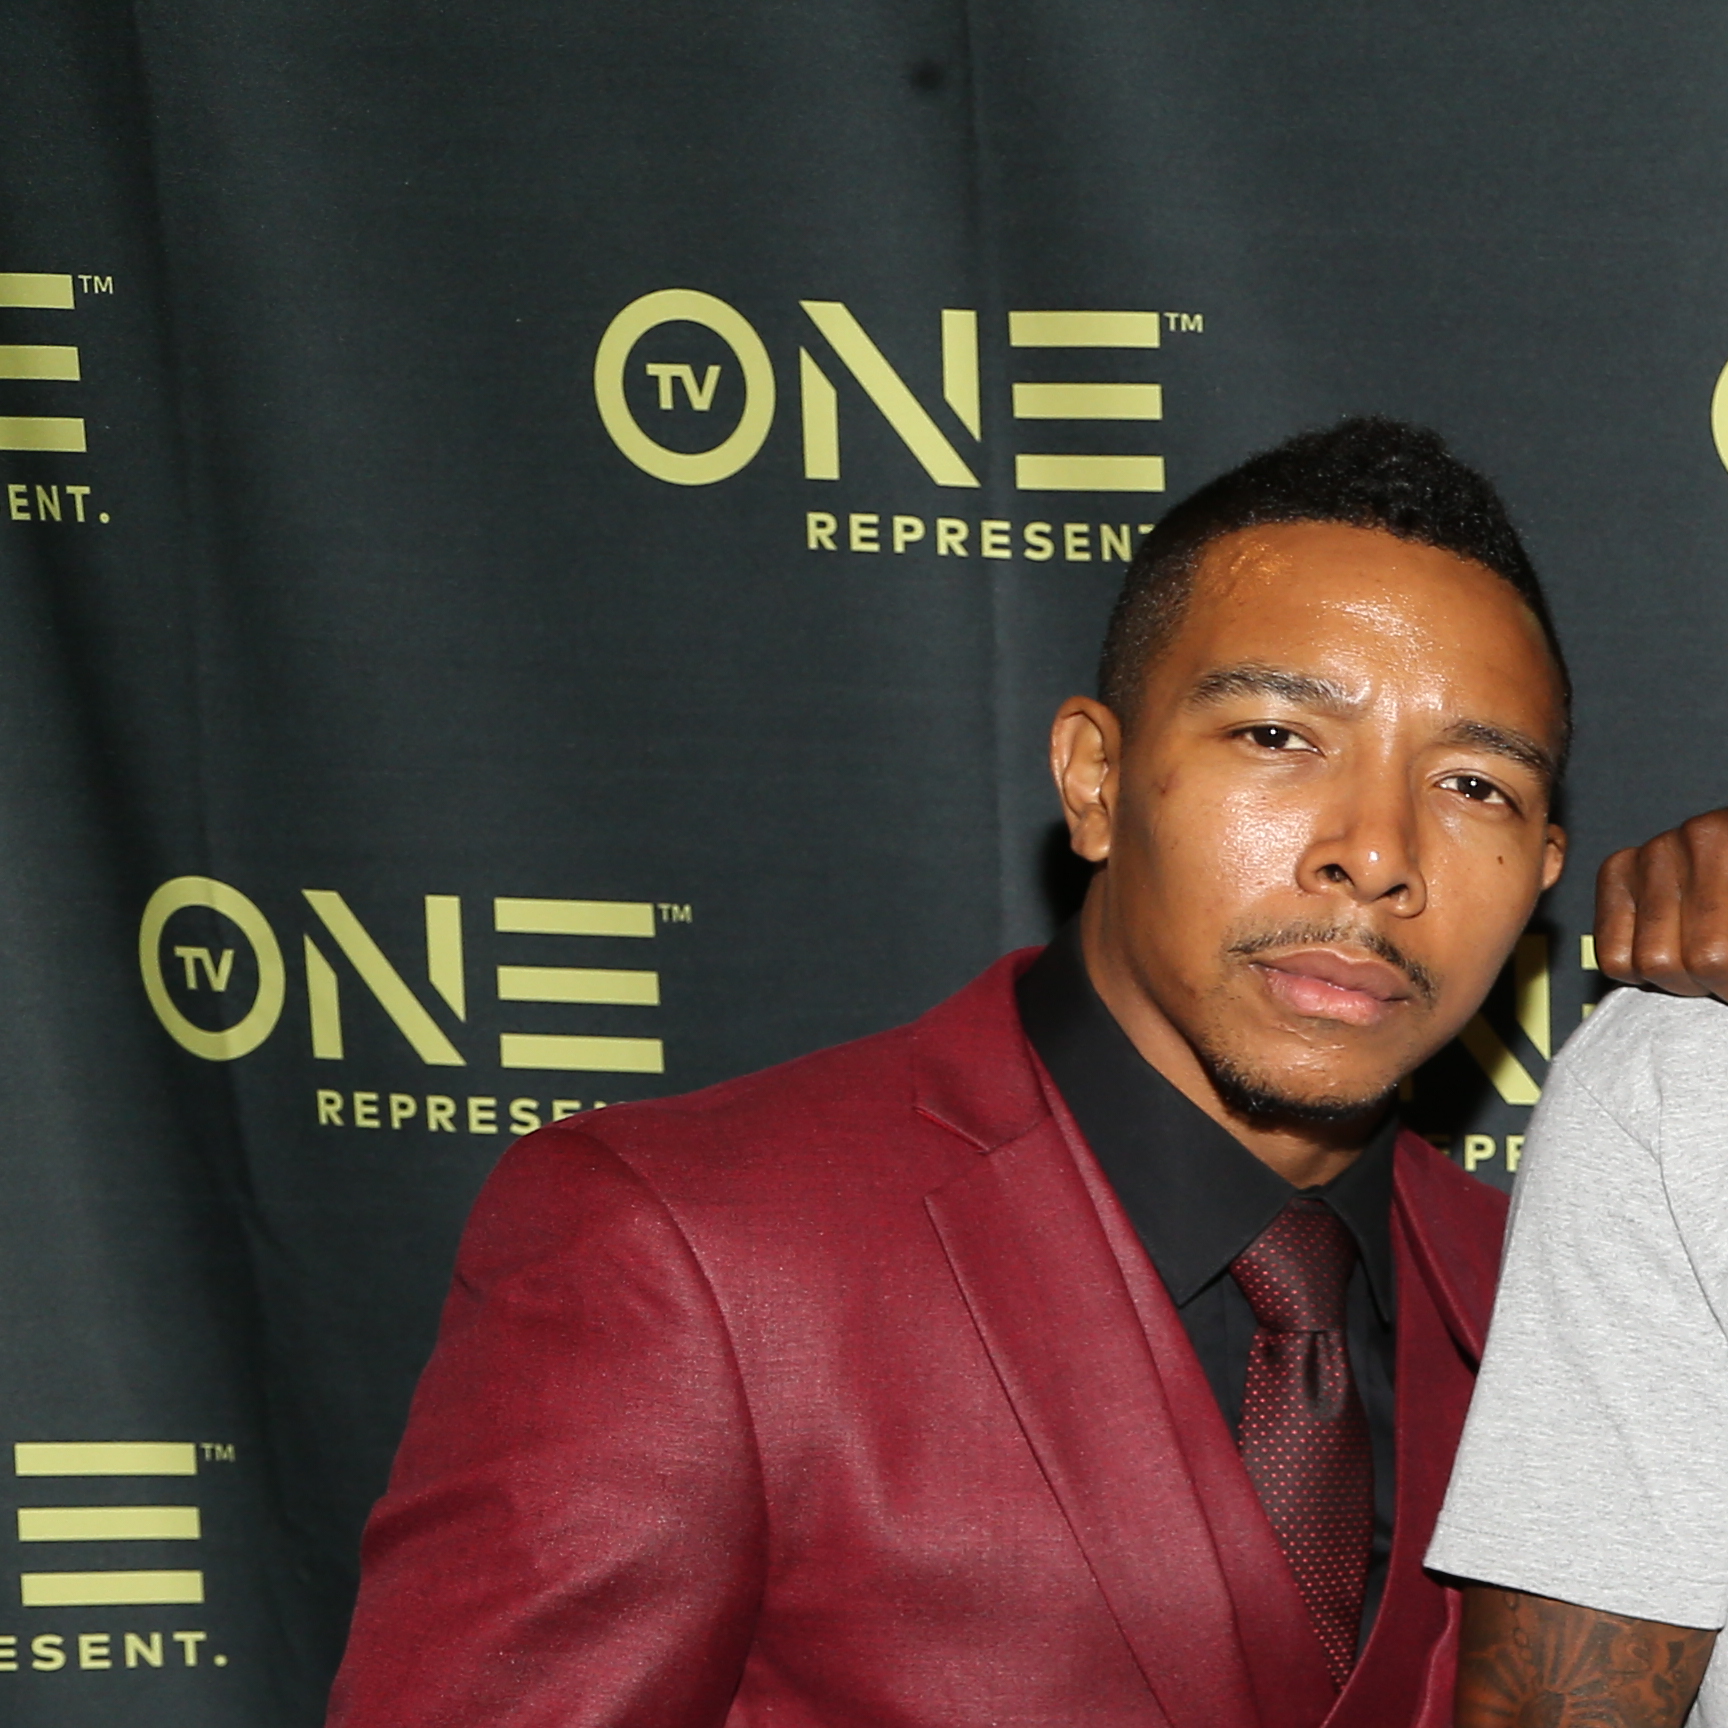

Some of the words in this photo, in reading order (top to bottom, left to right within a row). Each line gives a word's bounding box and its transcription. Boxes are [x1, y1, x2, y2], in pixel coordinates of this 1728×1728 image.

[593, 288, 1166, 493] ONE
[645, 362, 722, 412] TV
[806, 511, 1155, 563] REPRESEN
[139, 875, 665, 1074] ONE
[174, 946, 235, 992] TV
